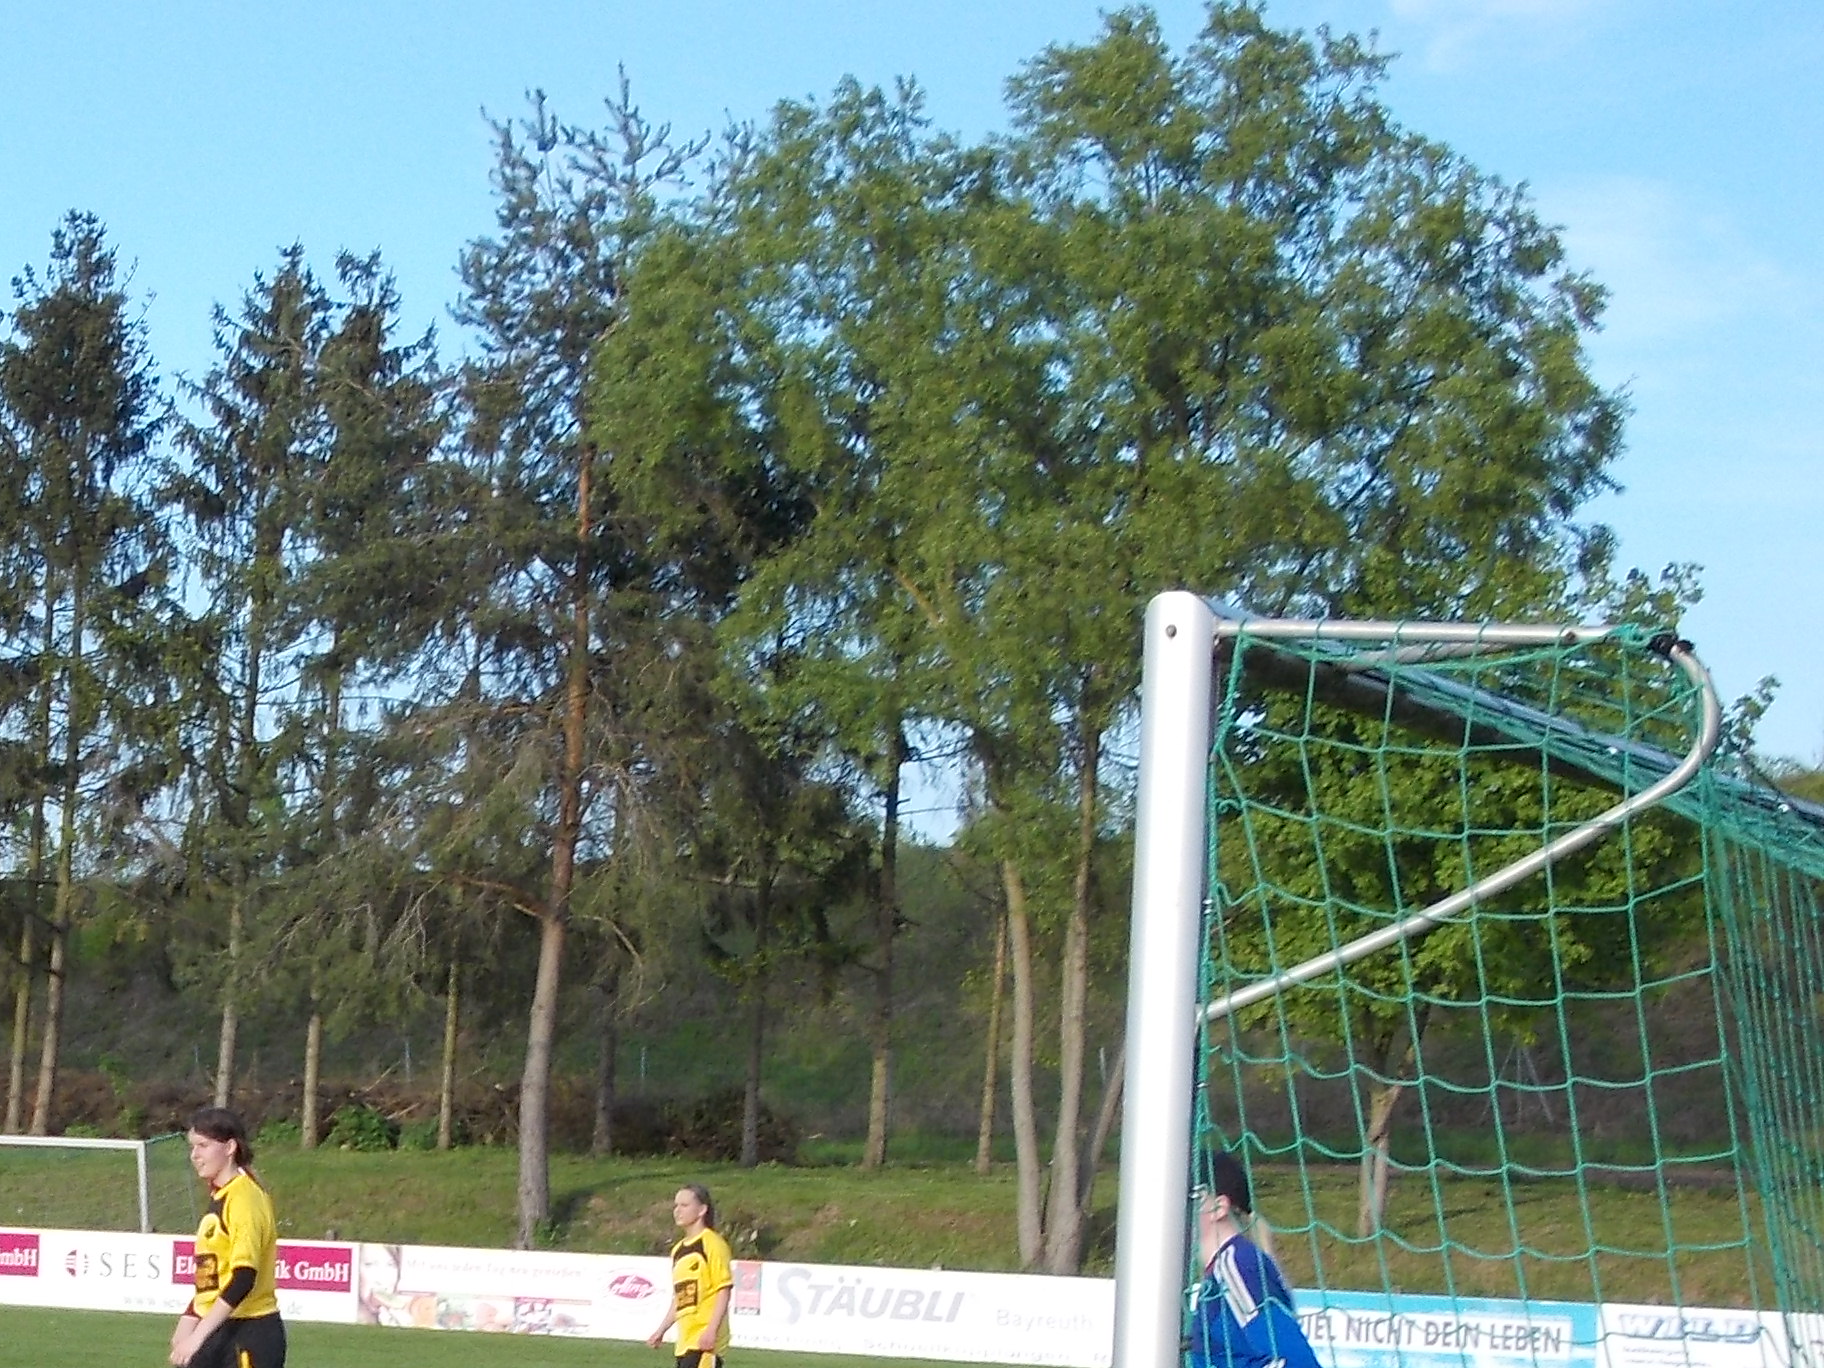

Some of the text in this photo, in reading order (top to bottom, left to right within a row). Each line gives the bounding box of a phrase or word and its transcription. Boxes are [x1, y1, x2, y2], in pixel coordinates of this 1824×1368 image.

[293, 1261, 350, 1283] GmbH
[777, 1267, 966, 1326] STÄUBLI
[1345, 1316, 1416, 1346] NICHT
[1425, 1320, 1480, 1348] DEIN
[1489, 1322, 1562, 1353] LEBEN
